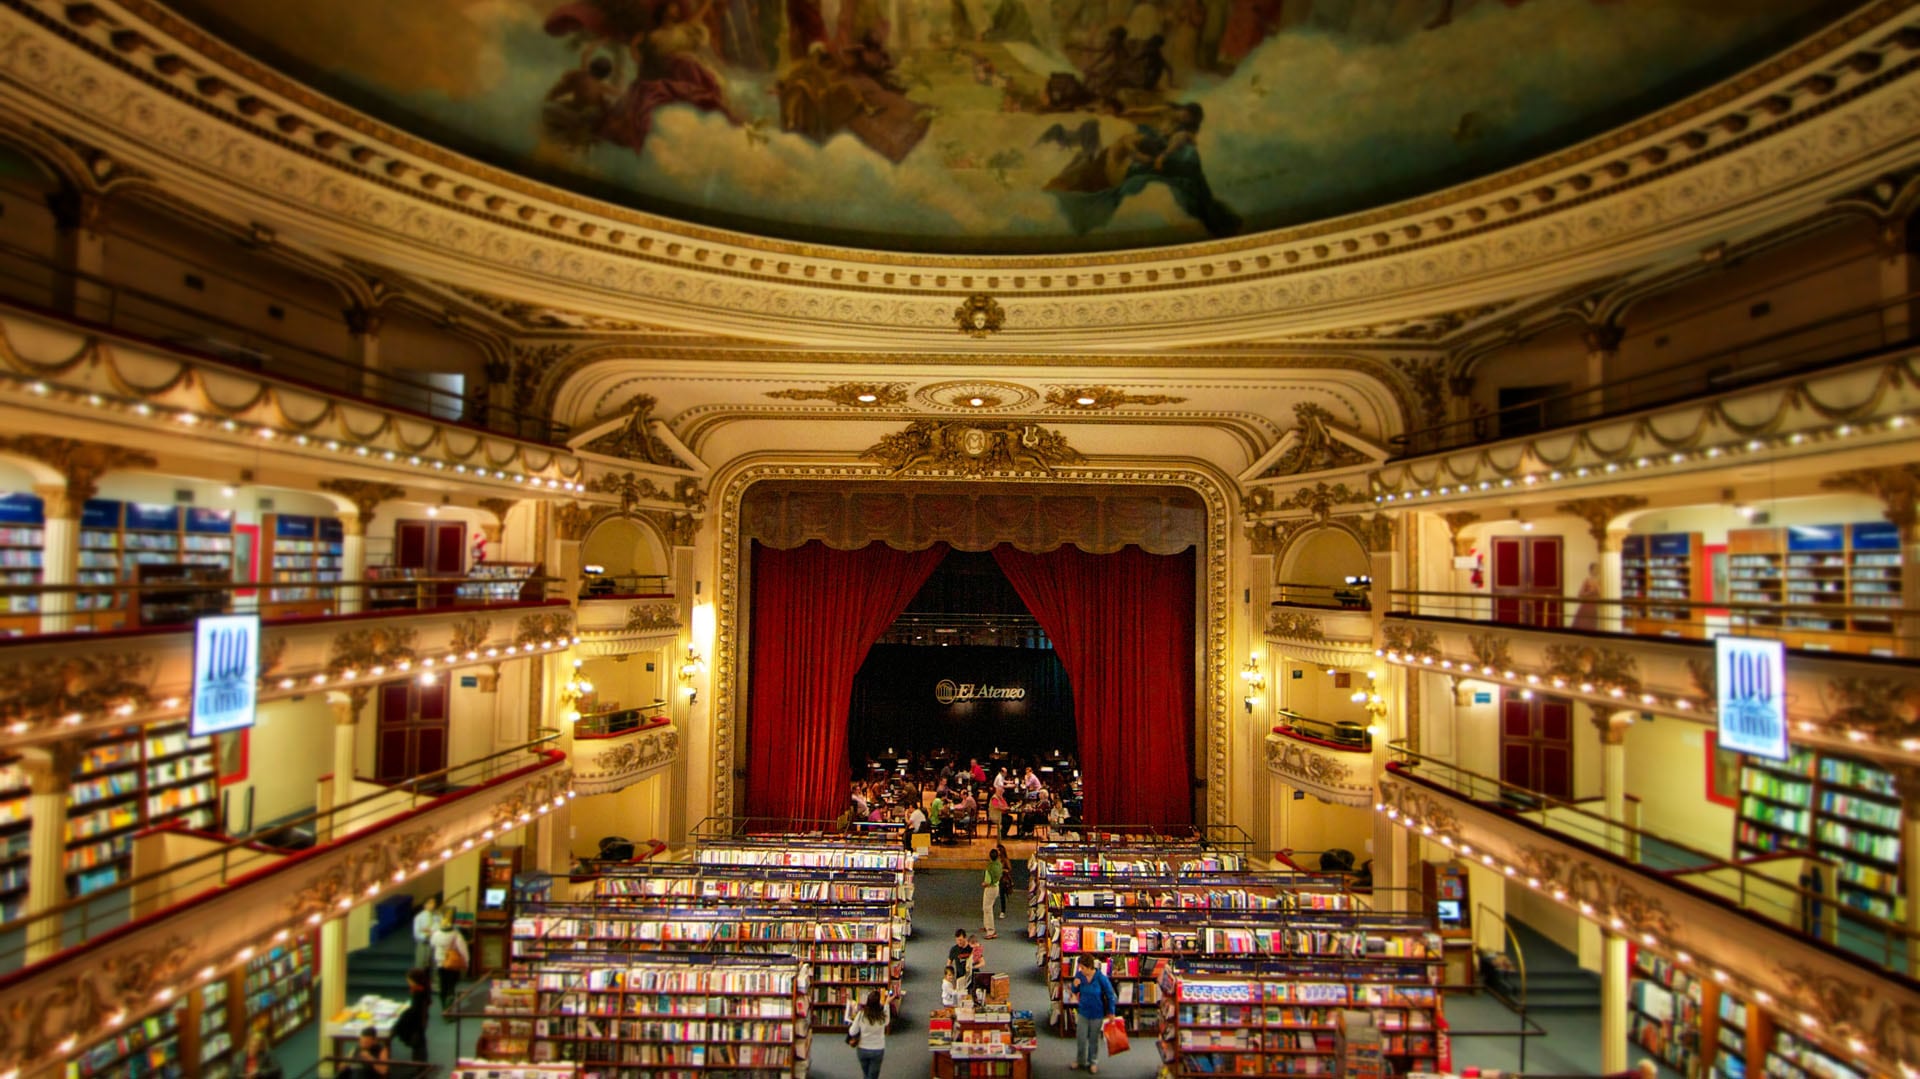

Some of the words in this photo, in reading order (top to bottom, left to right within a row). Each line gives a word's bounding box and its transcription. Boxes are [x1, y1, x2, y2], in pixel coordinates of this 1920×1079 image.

[207, 628, 248, 681] 100
[1728, 649, 1771, 704] 100
[957, 683, 975, 699] El
[976, 685, 1025, 699] Ateneo
